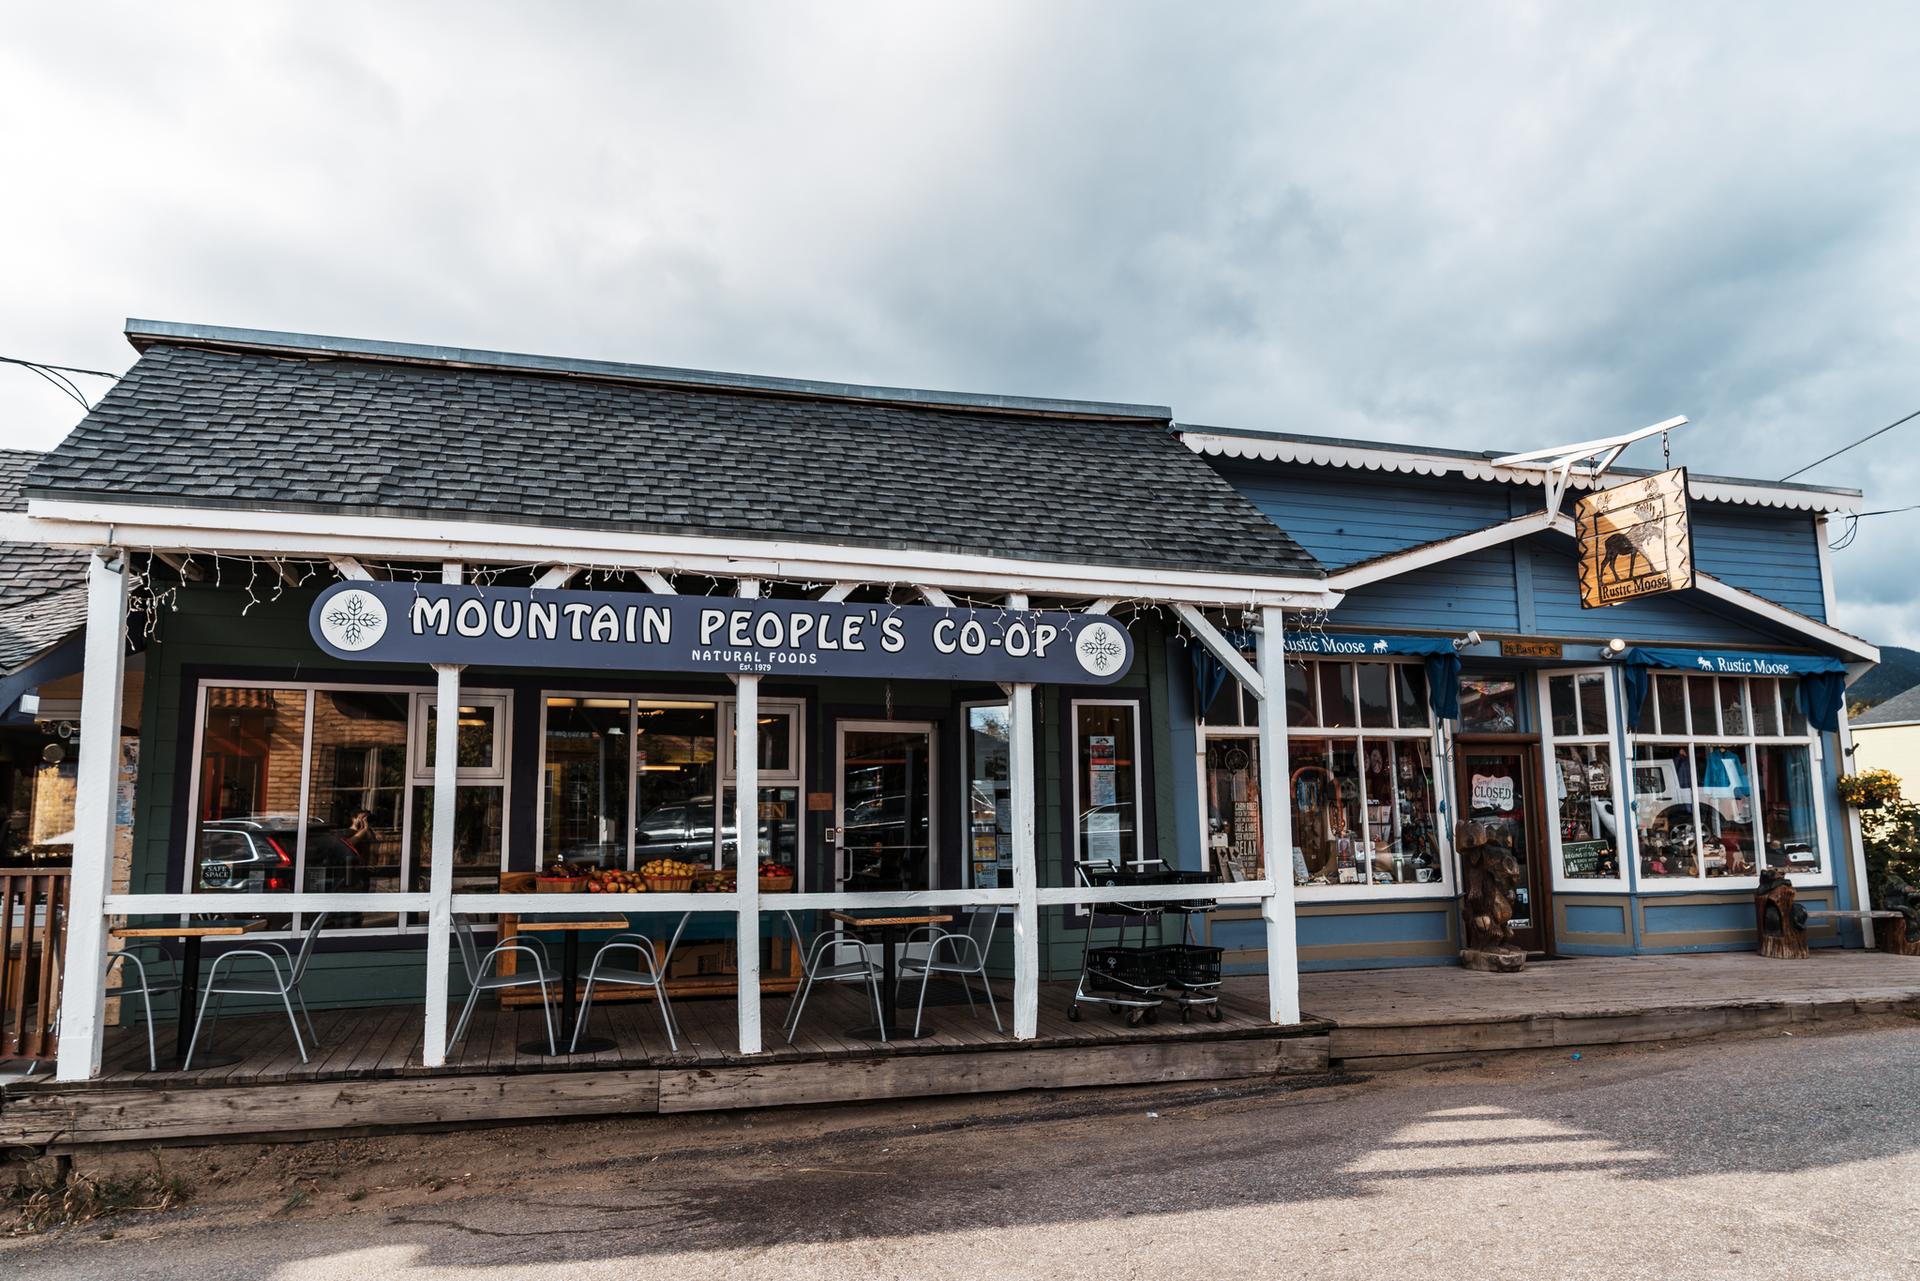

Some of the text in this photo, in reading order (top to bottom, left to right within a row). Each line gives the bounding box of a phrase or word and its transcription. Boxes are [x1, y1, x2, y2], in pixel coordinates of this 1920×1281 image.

[1602, 577, 1667, 600] Rustic Moose
[411, 596, 1059, 659] MOUNTAIN PEOPLE'S CO-OP
[1320, 638, 1366, 654] Moose
[691, 649, 817, 664] NATURAL FOODS
[739, 663, 771, 671] Est. 1979
[1717, 656, 1789, 675] Rustic Moose
[1474, 785, 1512, 800] CLOSED
